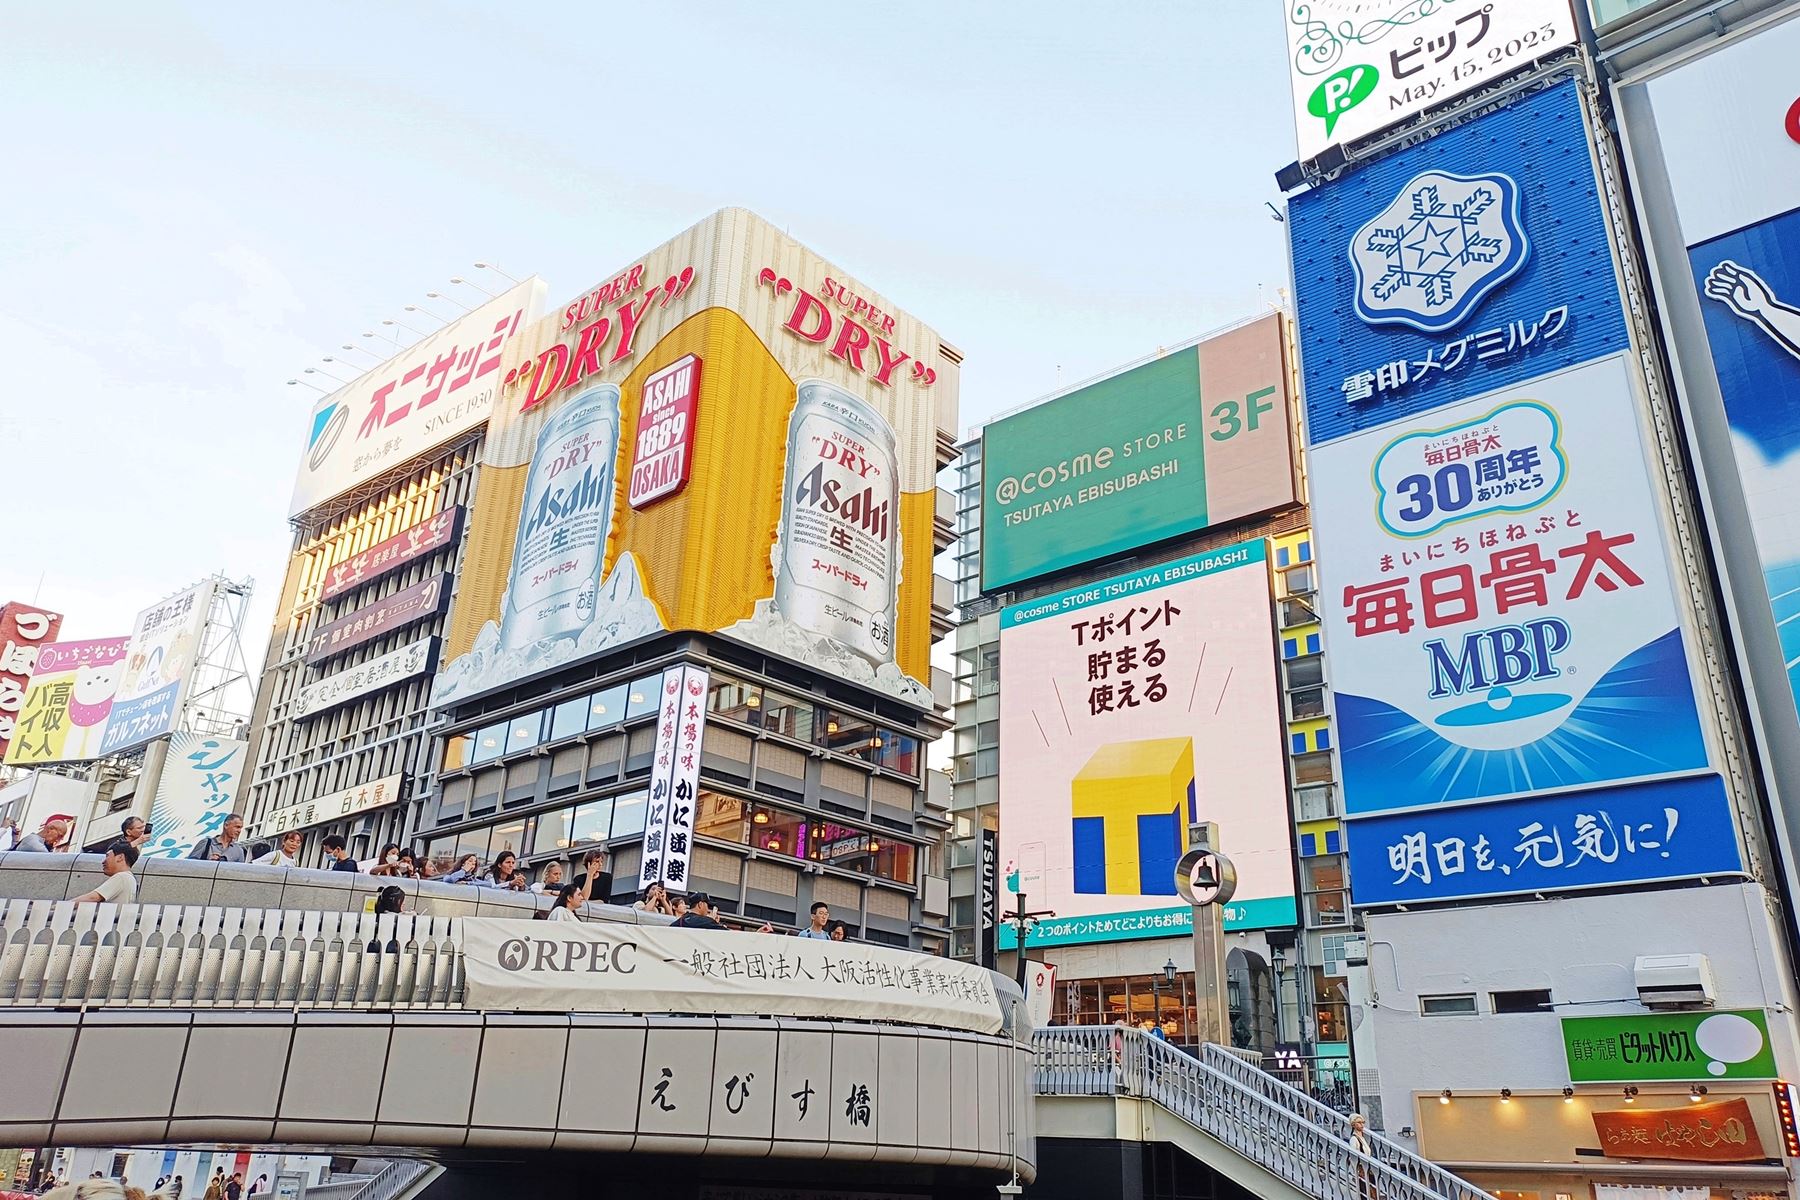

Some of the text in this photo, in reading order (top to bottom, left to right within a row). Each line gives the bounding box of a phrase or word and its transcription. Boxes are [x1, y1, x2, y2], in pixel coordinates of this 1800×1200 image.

[1389, 4, 1494, 80] ピップ
[1389, 22, 1557, 110] May. 15, 2023
[562, 262, 645, 332] SUPER
[820, 276, 896, 335] SUPER
[1340, 304, 1569, 404] 雪印メグミルク
[423, 388, 492, 436] SINCE 1930
[641, 365, 692, 417] ASAHI
[652, 405, 676, 424] since
[1209, 385, 1276, 442] 3F
[561, 432, 590, 453] SUPER
[636, 411, 687, 462] 1889
[831, 431, 865, 455] SUPER
[995, 423, 1188, 506] @cosme STORE
[1423, 424, 1500, 451] まいにちほねぶと
[1424, 434, 1502, 466] 毎日骨太
[526, 461, 607, 540] Asahi
[632, 449, 680, 499] OSAKA
[795, 461, 887, 543] Asahi
[1003, 459, 1179, 527] TSUTAYA EBISUBASHI
[1477, 473, 1544, 502] ありがとう
[549, 527, 570, 551] 生
[830, 525, 853, 553] 生
[1380, 509, 1582, 573] まいにちほねぶと
[532, 559, 579, 587] スーパードライ
[812, 559, 868, 591] スーパードライ
[1013, 548, 1249, 622] @cosme STORE TSUTAYA EBISUBASHI
[1343, 530, 1645, 638] 毎日骨太
[311, 632, 328, 655] 7F
[418, 580, 438, 610] 刀
[1071, 599, 1181, 646] Tポイント
[1087, 638, 1167, 682] 貯まる
[1424, 617, 1572, 700] MBP
[15, 684, 52, 759] バイト
[32, 682, 74, 757] 高収入
[1088, 673, 1168, 716] 使える
[104, 704, 169, 747] ガルフネット
[277, 804, 316, 833] 白木屋
[341, 783, 385, 814] 白木屋
[643, 700, 675, 881] 本場の味 かに道楽
[667, 701, 699, 883] 本場の味 かに道楽
[982, 838, 993, 930] TSUTAYA
[497, 936, 637, 974] ORPEC
[663, 948, 815, 981] 一般社団法人
[821, 955, 992, 1007] 大阪活性化事業実行委員会
[1619, 1030, 1696, 1064] ピタットハウス
[651, 1067, 871, 1128] えびす橋
